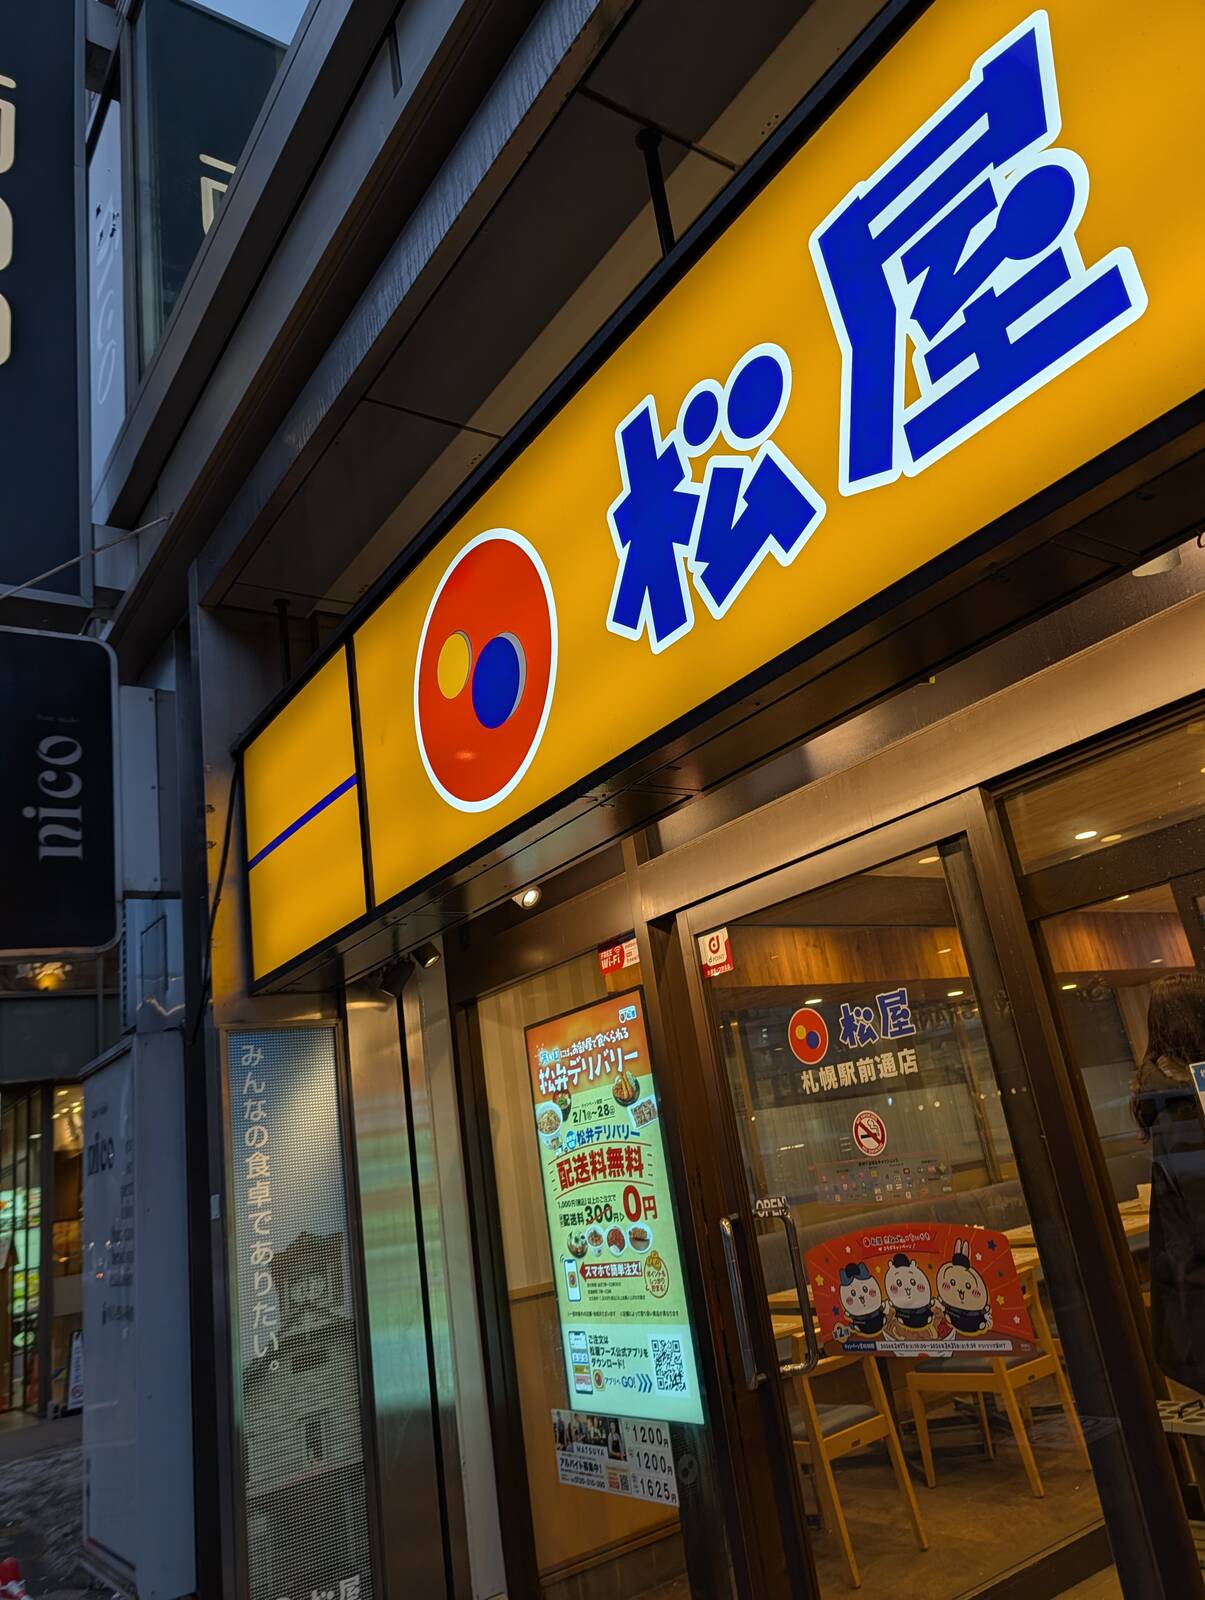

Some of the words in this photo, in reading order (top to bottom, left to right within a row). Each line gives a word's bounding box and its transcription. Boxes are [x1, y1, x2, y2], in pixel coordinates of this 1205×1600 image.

[606, 9, 1148, 655] 松屋
[22, 735, 84, 862] nico
[600, 948, 613, 960] FREE
[601, 953, 620, 969] Wi-Fi
[840, 987, 917, 1048] 松屋
[539, 1048, 639, 1095] 松弁デリバリー
[800, 1048, 919, 1095] 札幌駅前通店
[556, 1145, 644, 1191] 配送料無料
[240, 1044, 280, 1372] みんなの食卓でありたい。
[623, 1185, 659, 1222] 0円
[576, 1444, 605, 1457] MATSUYA
